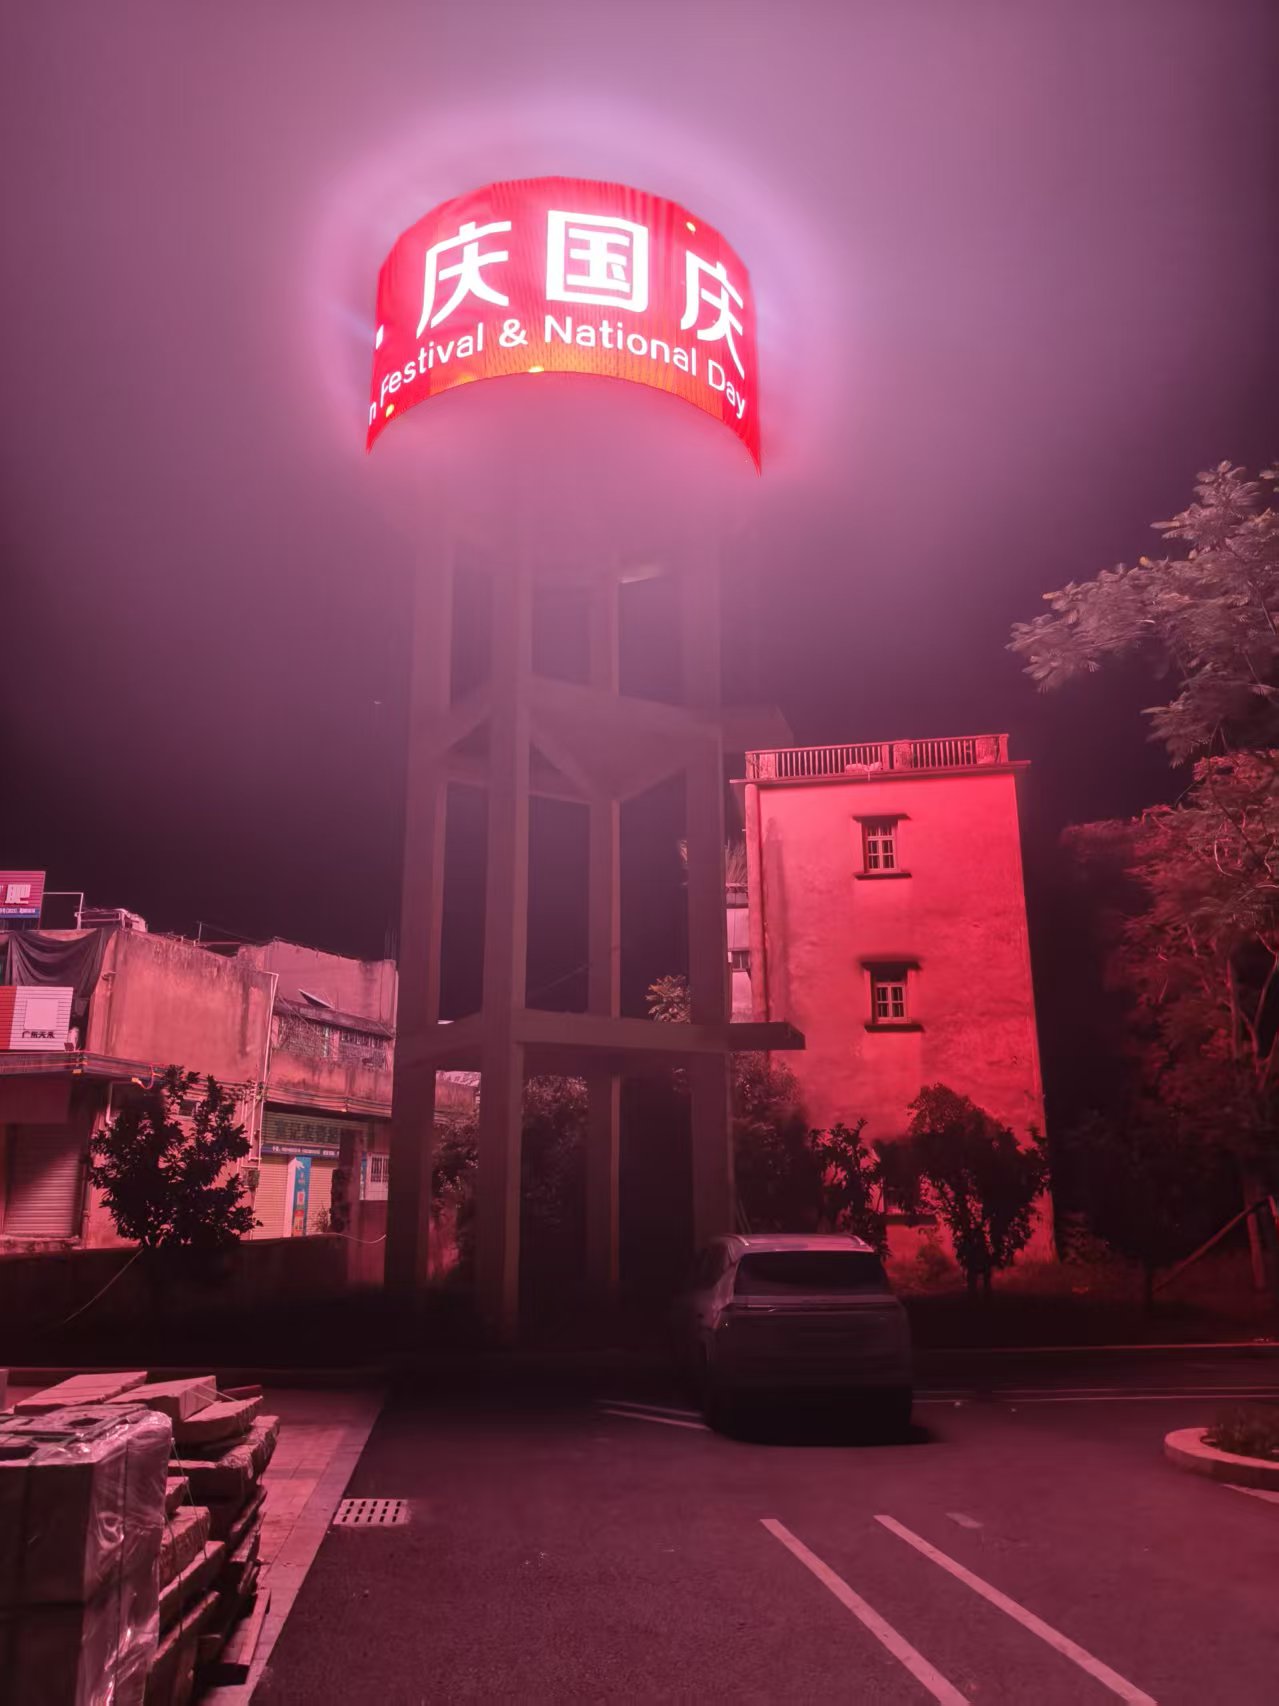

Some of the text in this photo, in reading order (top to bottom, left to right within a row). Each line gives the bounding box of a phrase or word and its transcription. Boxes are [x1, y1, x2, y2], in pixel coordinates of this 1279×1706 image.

[380, 321, 484, 408] Festival
[498, 318, 529, 348] &
[544, 314, 697, 377] National
[708, 358, 746, 420] Day
